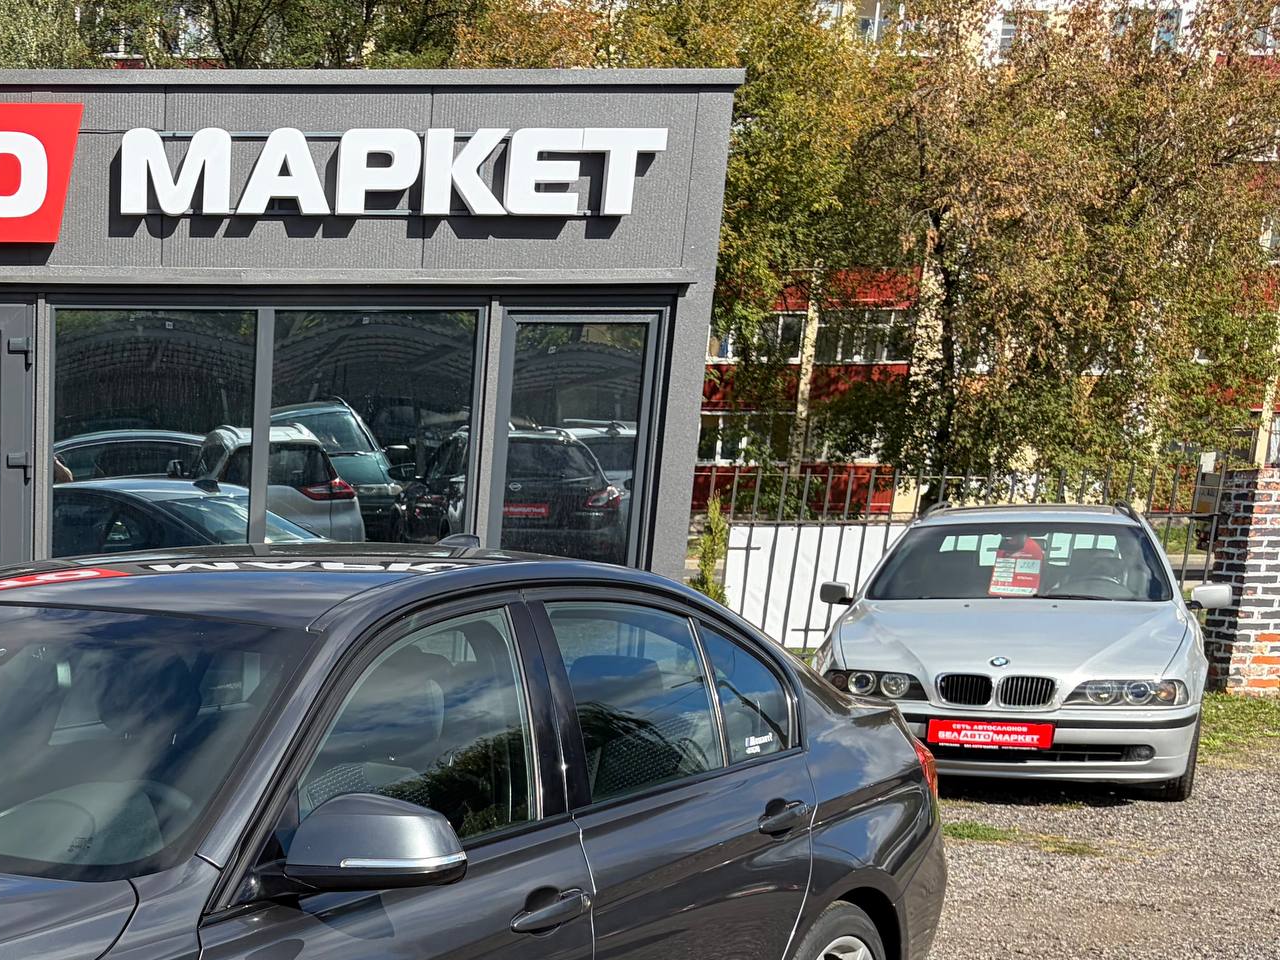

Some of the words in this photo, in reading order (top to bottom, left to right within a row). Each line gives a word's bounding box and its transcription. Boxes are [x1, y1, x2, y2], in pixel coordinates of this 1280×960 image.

[120, 127, 668, 216] МАРКЕТ
[973, 724, 1028, 732] АВТОСАЛОНОВ
[938, 731, 960, 740] БЕЛ
[961, 731, 992, 741] АВТО
[993, 733, 1040, 744] МАРКЕТ
